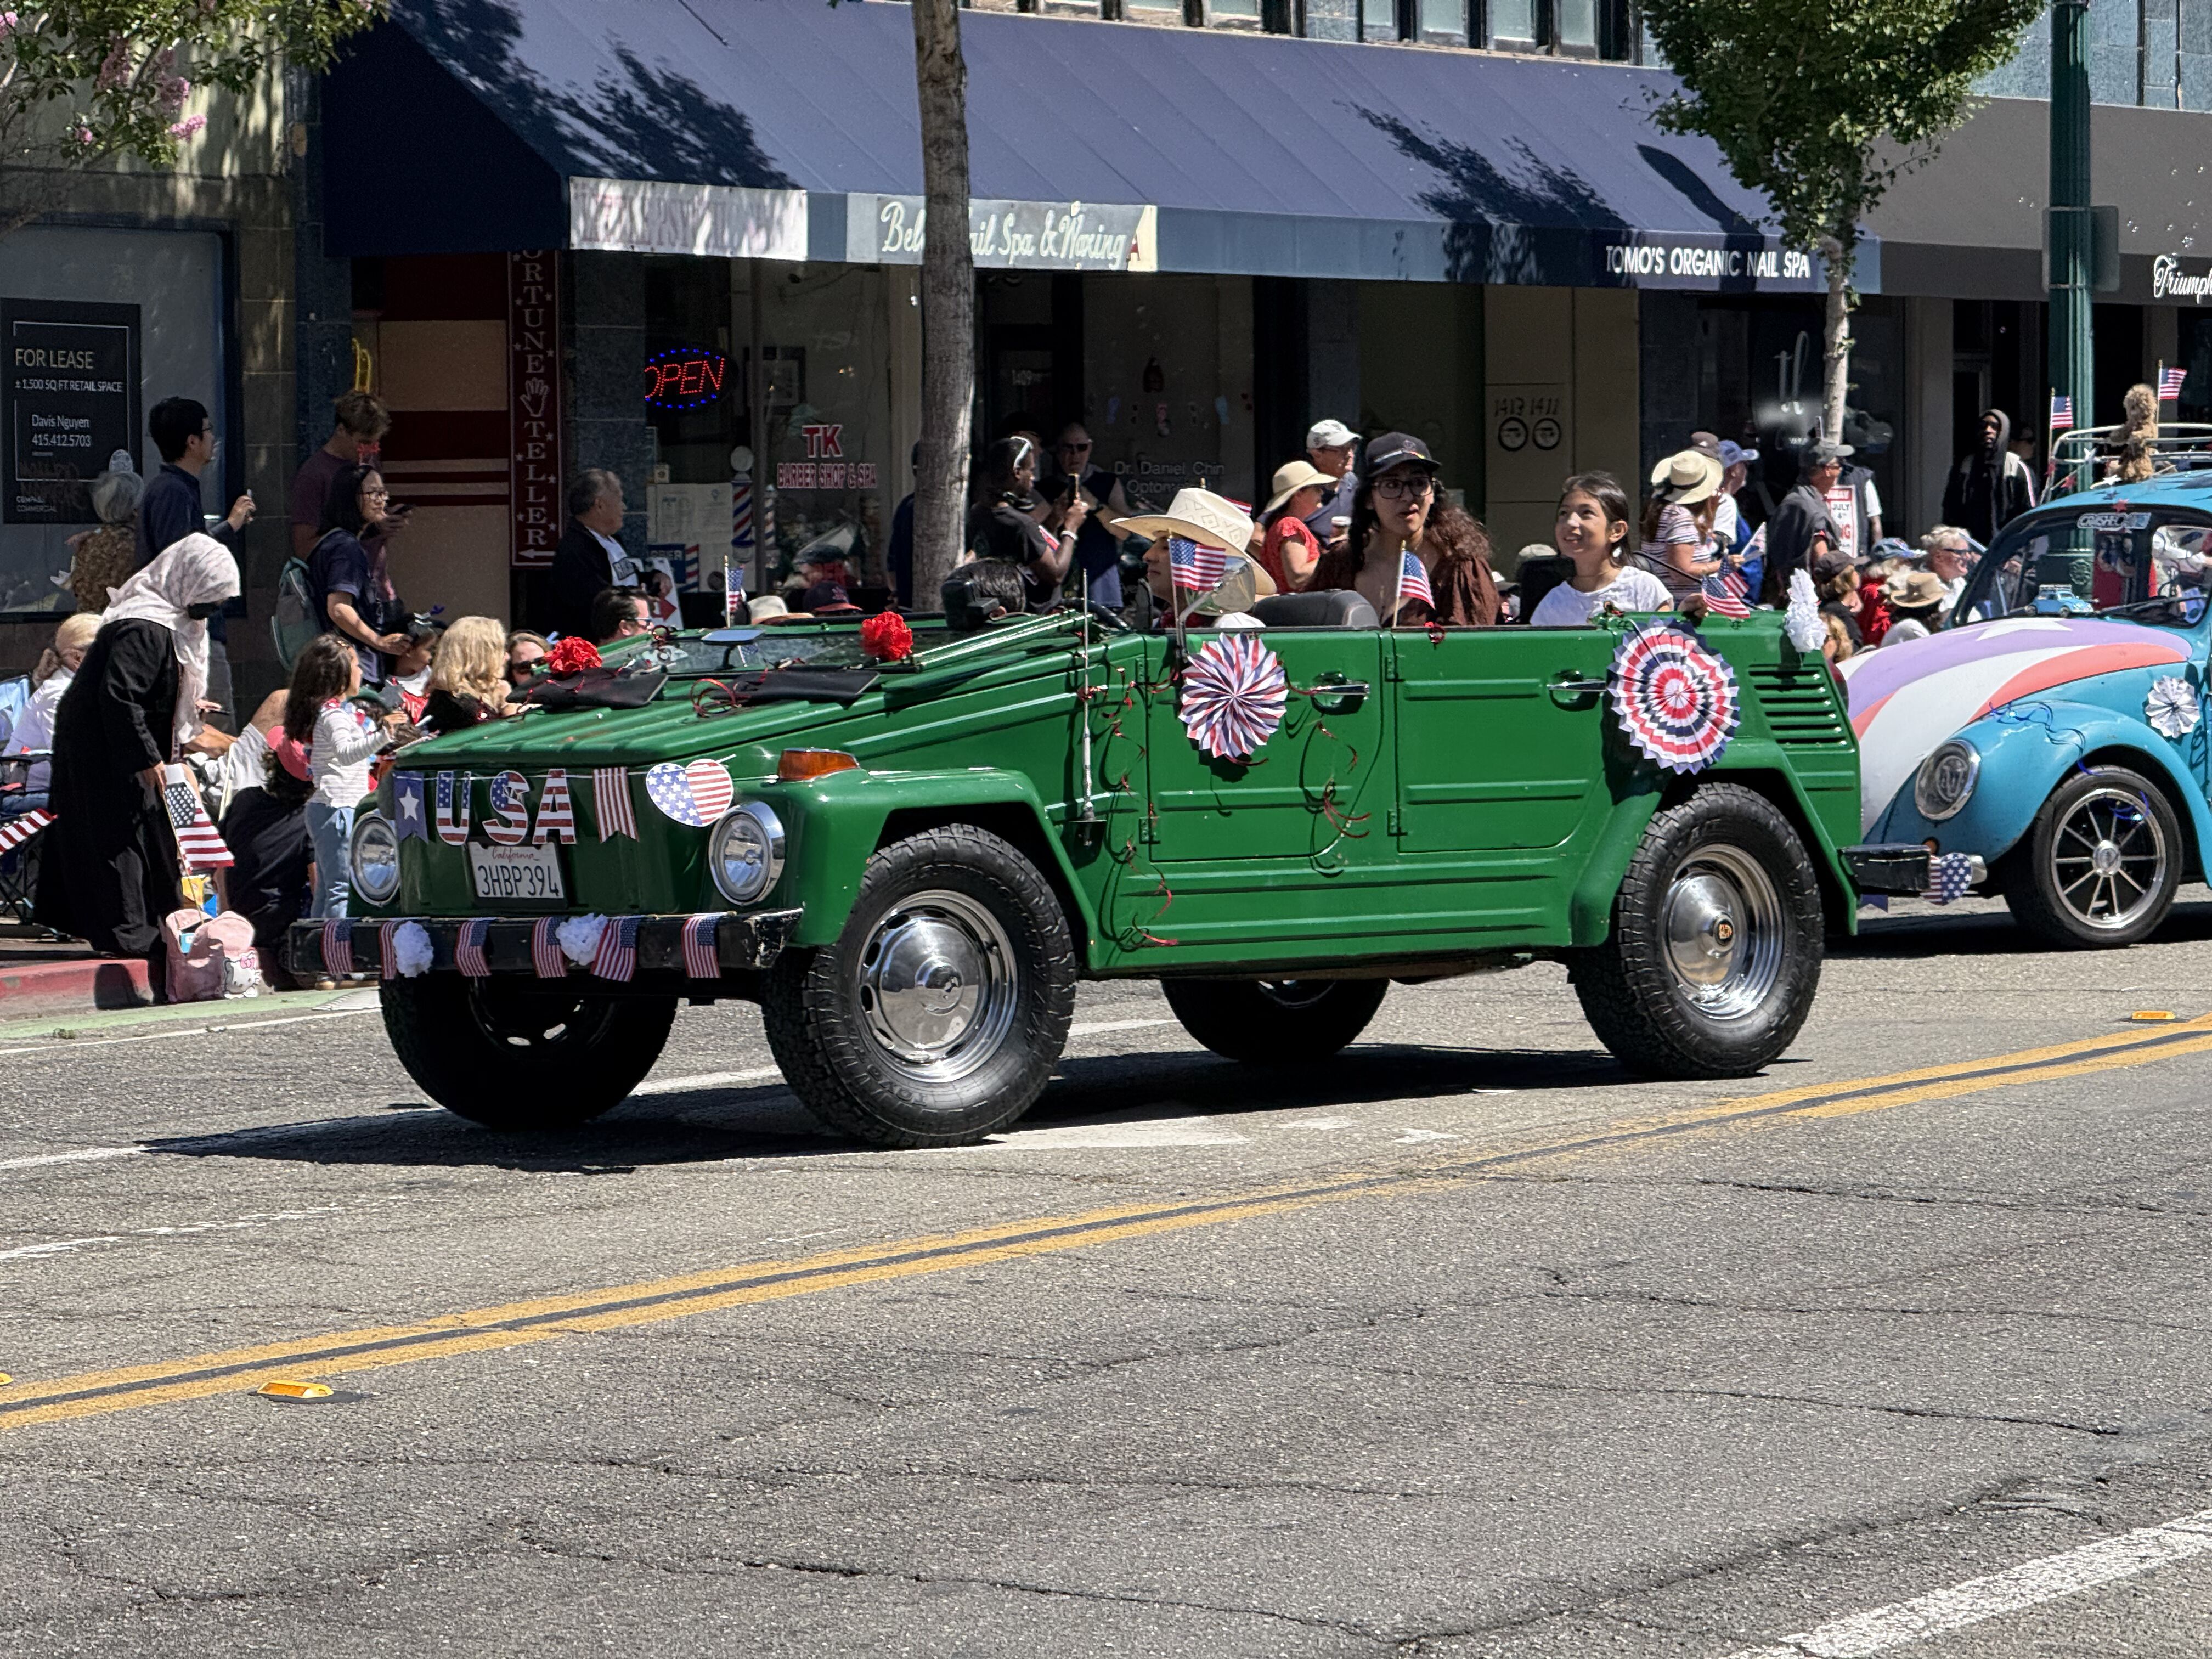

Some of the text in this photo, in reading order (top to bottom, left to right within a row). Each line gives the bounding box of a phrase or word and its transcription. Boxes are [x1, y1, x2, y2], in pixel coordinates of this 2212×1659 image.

[881, 201, 1127, 270] Bel ail Spa & Waxing
[1606, 245, 1811, 279] TOMO'S ORGANIC NAIL SPA
[15, 348, 95, 369] FOR LEASE
[45, 380, 57, 392] SQ
[70, 380, 97, 392] RETAIL
[98, 381, 123, 393] SPACE
[644, 357, 726, 399] OPEN
[521, 250, 548, 546] RTUNE TELLER
[31, 414, 90, 430] Davis Nguyen
[802, 424, 844, 459] TK
[777, 462, 878, 489] BARBER SHOP & SPA
[1114, 460, 1225, 475] Dr. Daniel Chin
[436, 768, 577, 846] USA
[492, 849, 534, 863] California
[478, 865, 560, 897] 3HBP394
